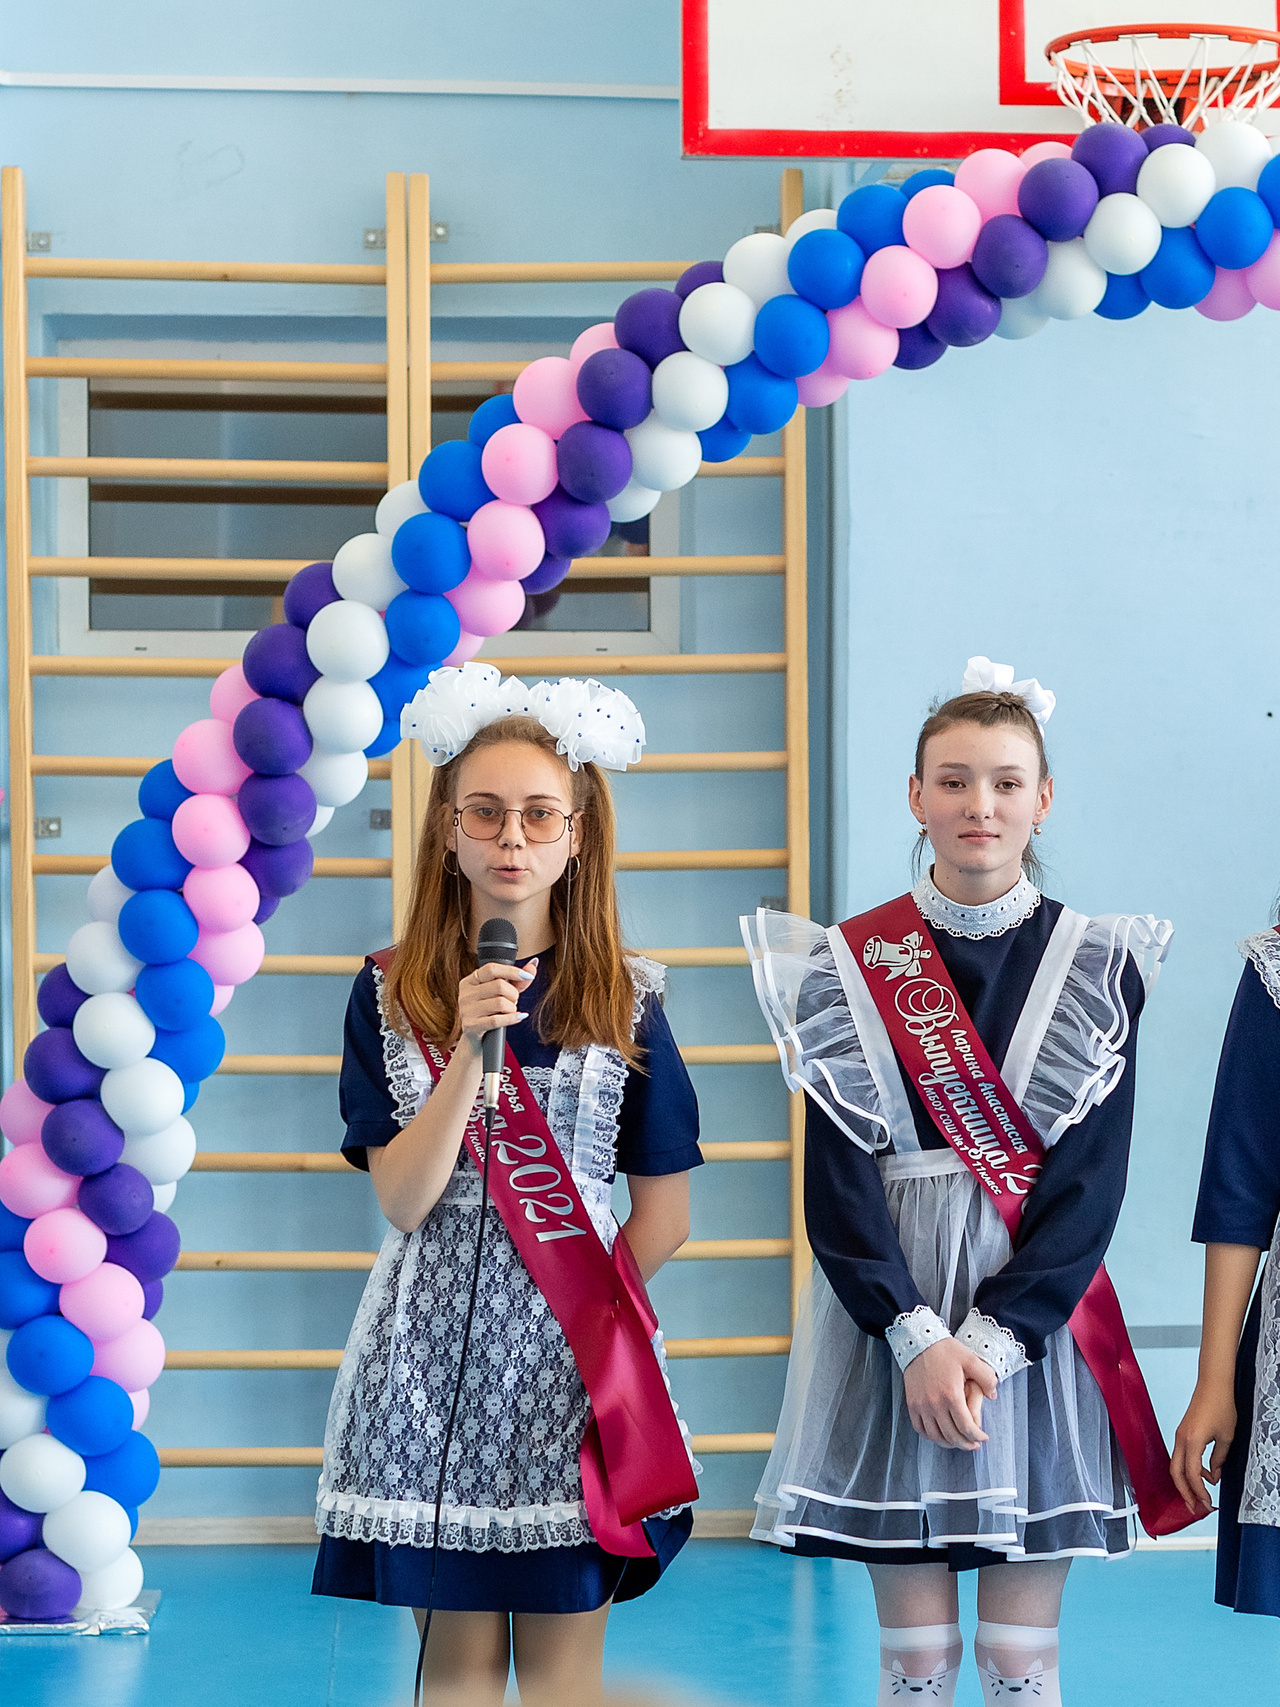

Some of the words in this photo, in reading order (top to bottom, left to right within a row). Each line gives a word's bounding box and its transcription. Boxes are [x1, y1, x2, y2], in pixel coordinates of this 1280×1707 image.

[426, 1043, 447, 1069] МБОУ
[500, 1066, 525, 1113] Софья
[895, 977, 1007, 1170] Выпускница
[950, 1028, 984, 1080] Ларина
[978, 1081, 1028, 1155] Анастасия
[923, 1086, 946, 1115] МБОУ
[939, 1113, 958, 1135] СОШ
[491, 1134, 587, 1244] 2021
